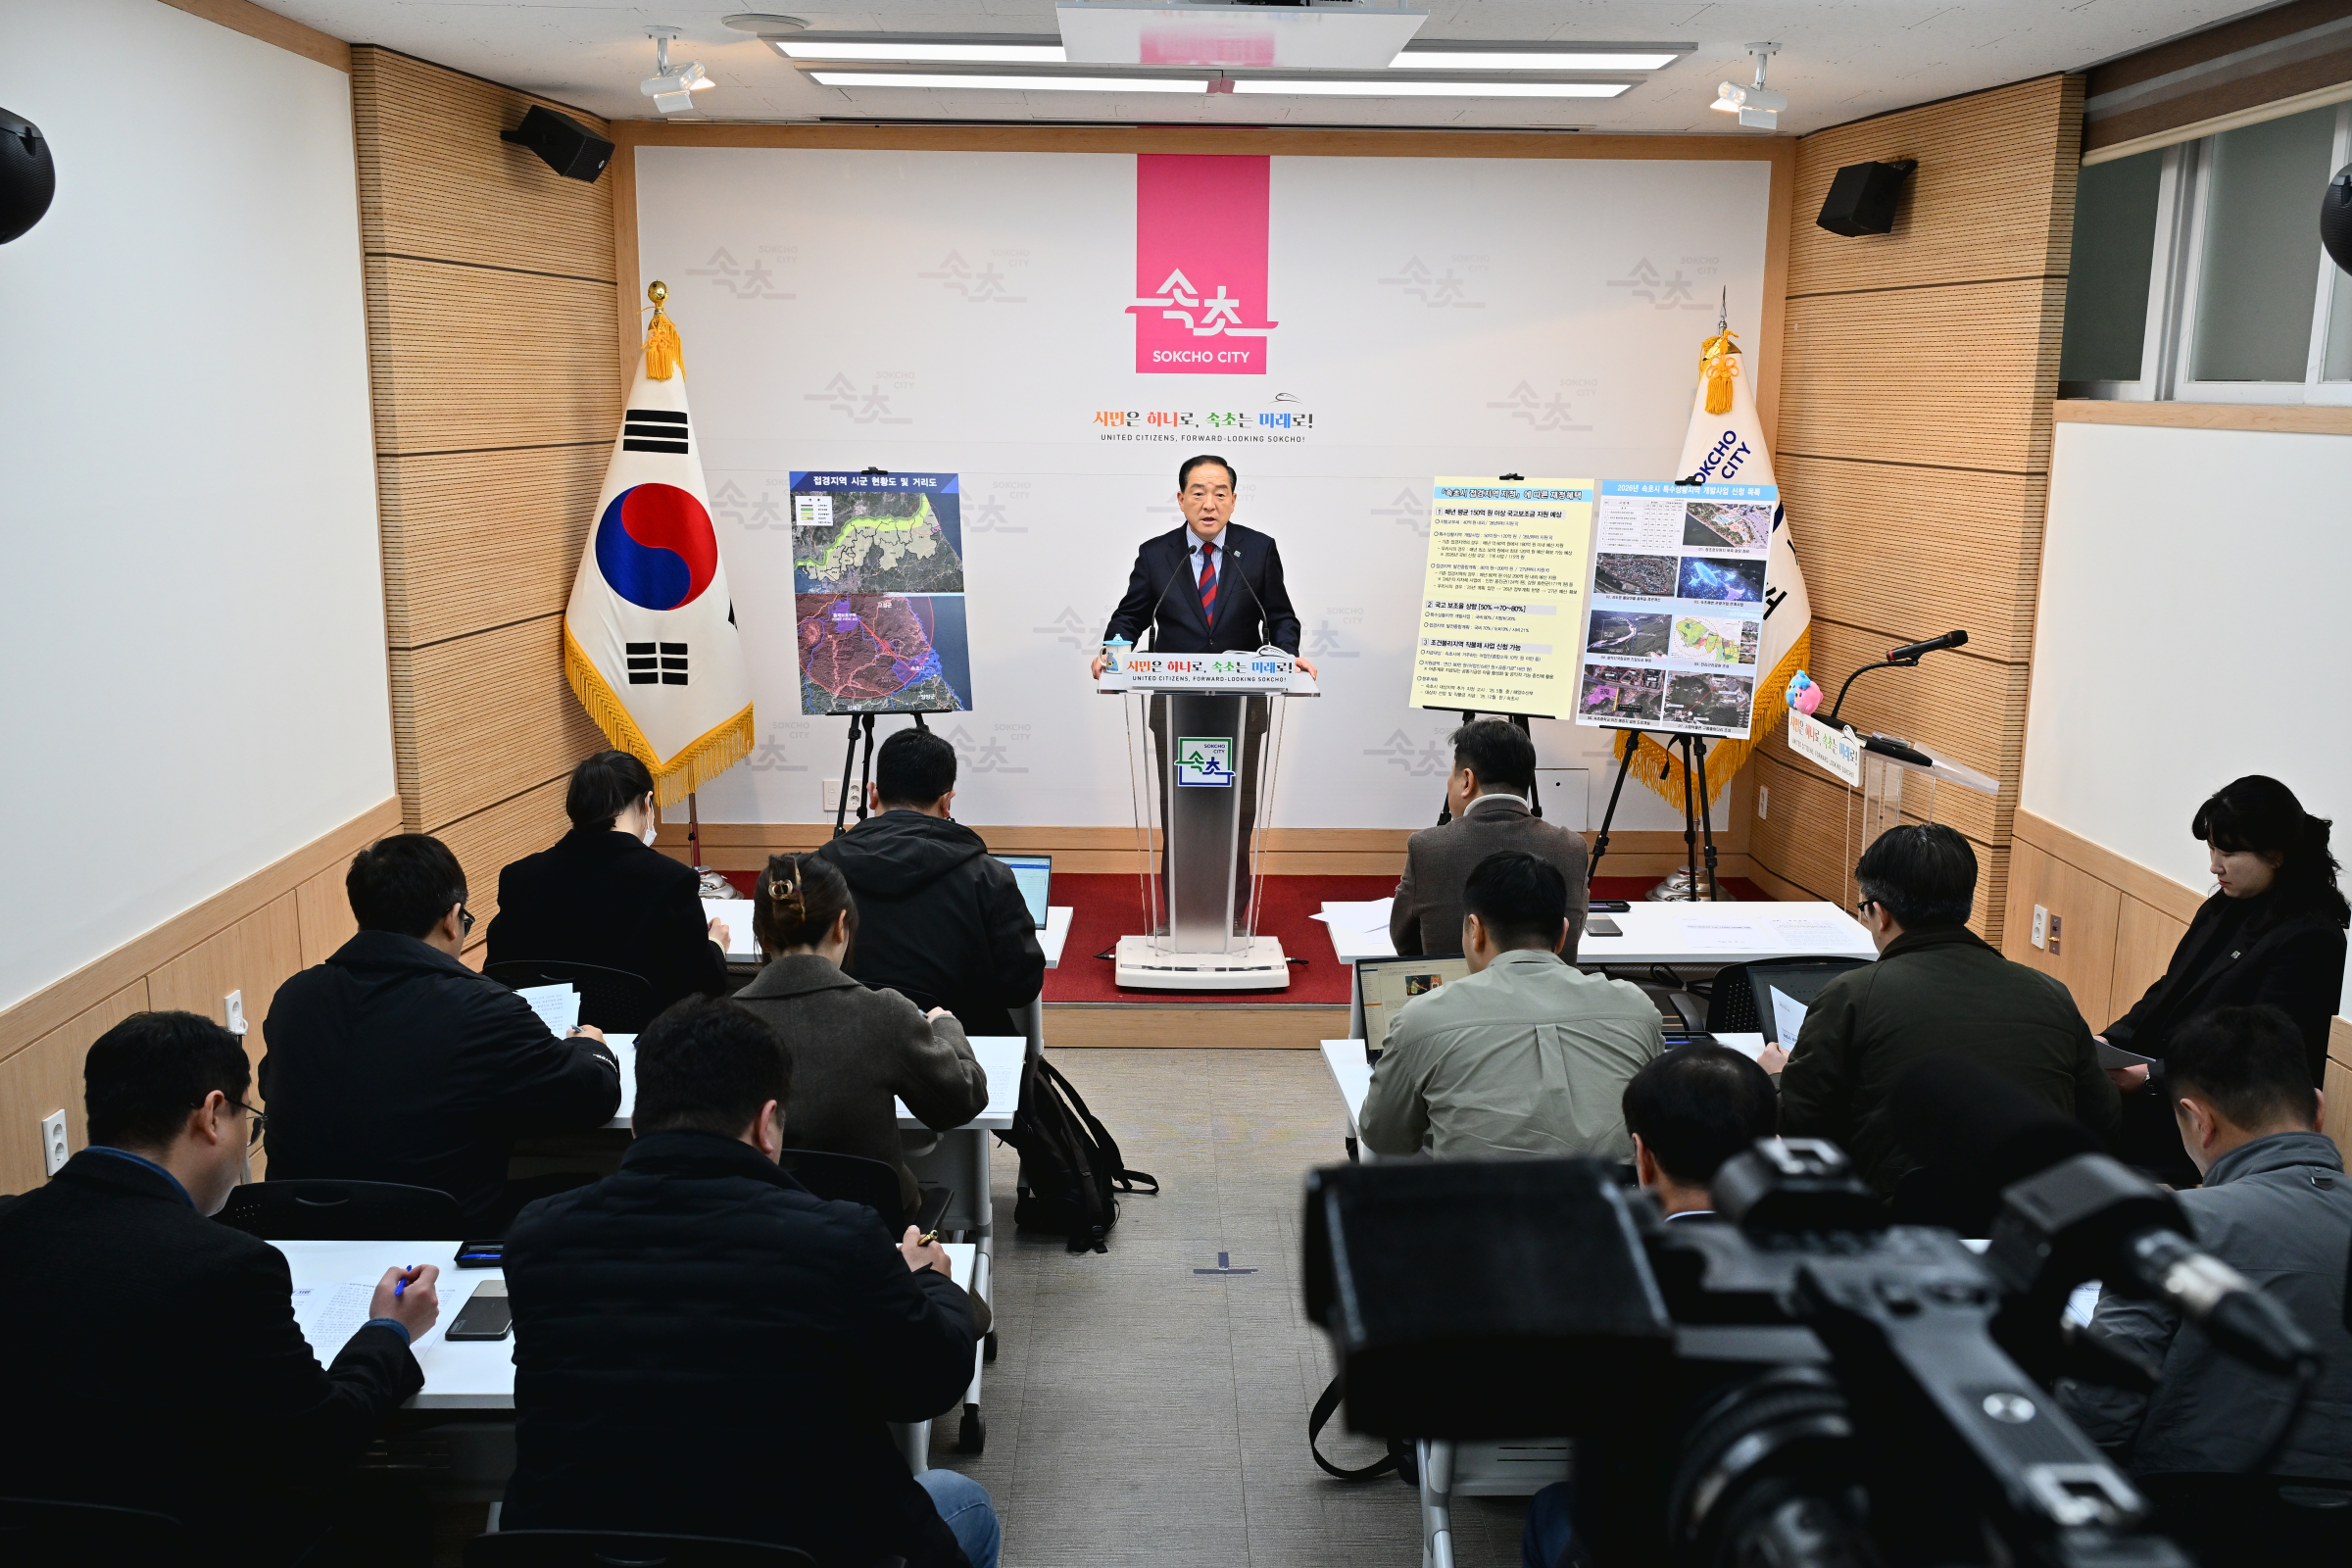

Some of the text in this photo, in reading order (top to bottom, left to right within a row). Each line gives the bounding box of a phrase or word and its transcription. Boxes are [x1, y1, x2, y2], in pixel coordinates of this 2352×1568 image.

[759, 245, 798, 254] SOKCHO
[776, 256, 797, 265] CITY
[1452, 254, 1490, 263] SOKCHO
[1680, 256, 1719, 265] SOKCHO
[1008, 259, 1029, 268] CITY
[1697, 267, 1718, 275] CITY
[1134, 268, 1268, 337] 속초
[1152, 350, 1250, 363] SOKCHO CITY
[876, 371, 915, 379] SOKCHO
[894, 381, 914, 390] CITY
[1560, 379, 1598, 387] SOKCHO
[1093, 411, 1313, 429] 시민은 하나로, 속초는 미래로!
[1694, 430, 1737, 484] OKCHO
[1721, 441, 1751, 479] CITY
[813, 476, 938, 488] 접경지역 시군 현황도 및 거리도
[993, 481, 1031, 490] SOKCHO
[1469, 488, 1499, 498] 접경지역
[1532, 490, 1548, 499] 따른
[1550, 490, 1582, 500] 재정혜택
[1617, 484, 1760, 496] 2026년 속초시 특수상황지역 개발사업 신청 목록
[1009, 491, 1031, 500] CITY
[1430, 639, 1464, 647] 조건불리지역
[1127, 661, 1292, 674] 시민은 하나로, 속초는 미래로!
[773, 721, 810, 730] SOKCHO
[994, 723, 1031, 732] SOKCHO
[1790, 715, 1804, 736] 시민은
[1823, 733, 1838, 755] 속초는
